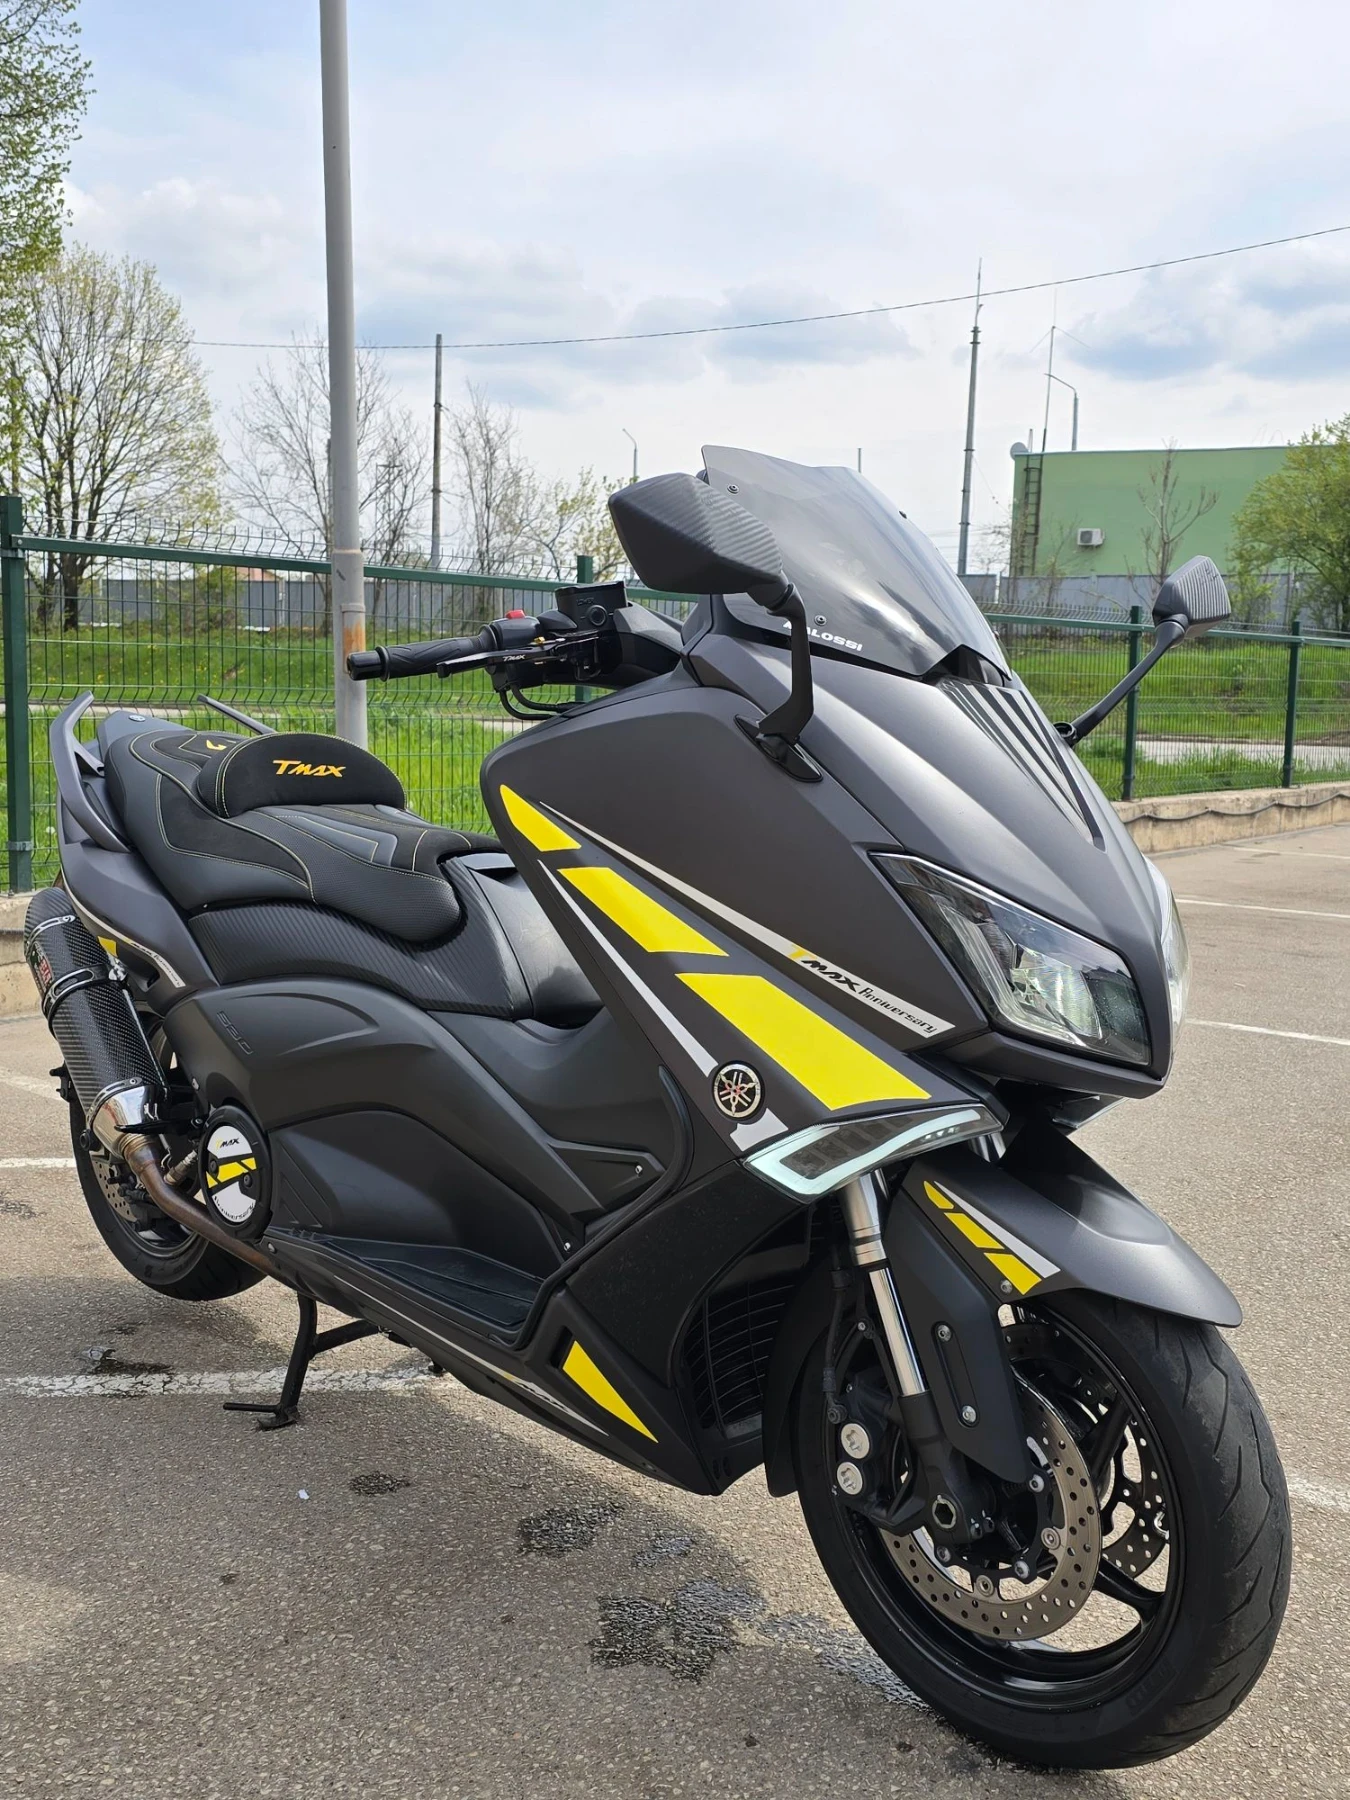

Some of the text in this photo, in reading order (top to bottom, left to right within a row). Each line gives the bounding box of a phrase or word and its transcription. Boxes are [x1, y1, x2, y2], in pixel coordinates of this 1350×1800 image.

[272, 759, 347, 778] TMAX
[787, 943, 938, 1034] TMAX Anniversary
[216, 1010, 254, 1055] 530
